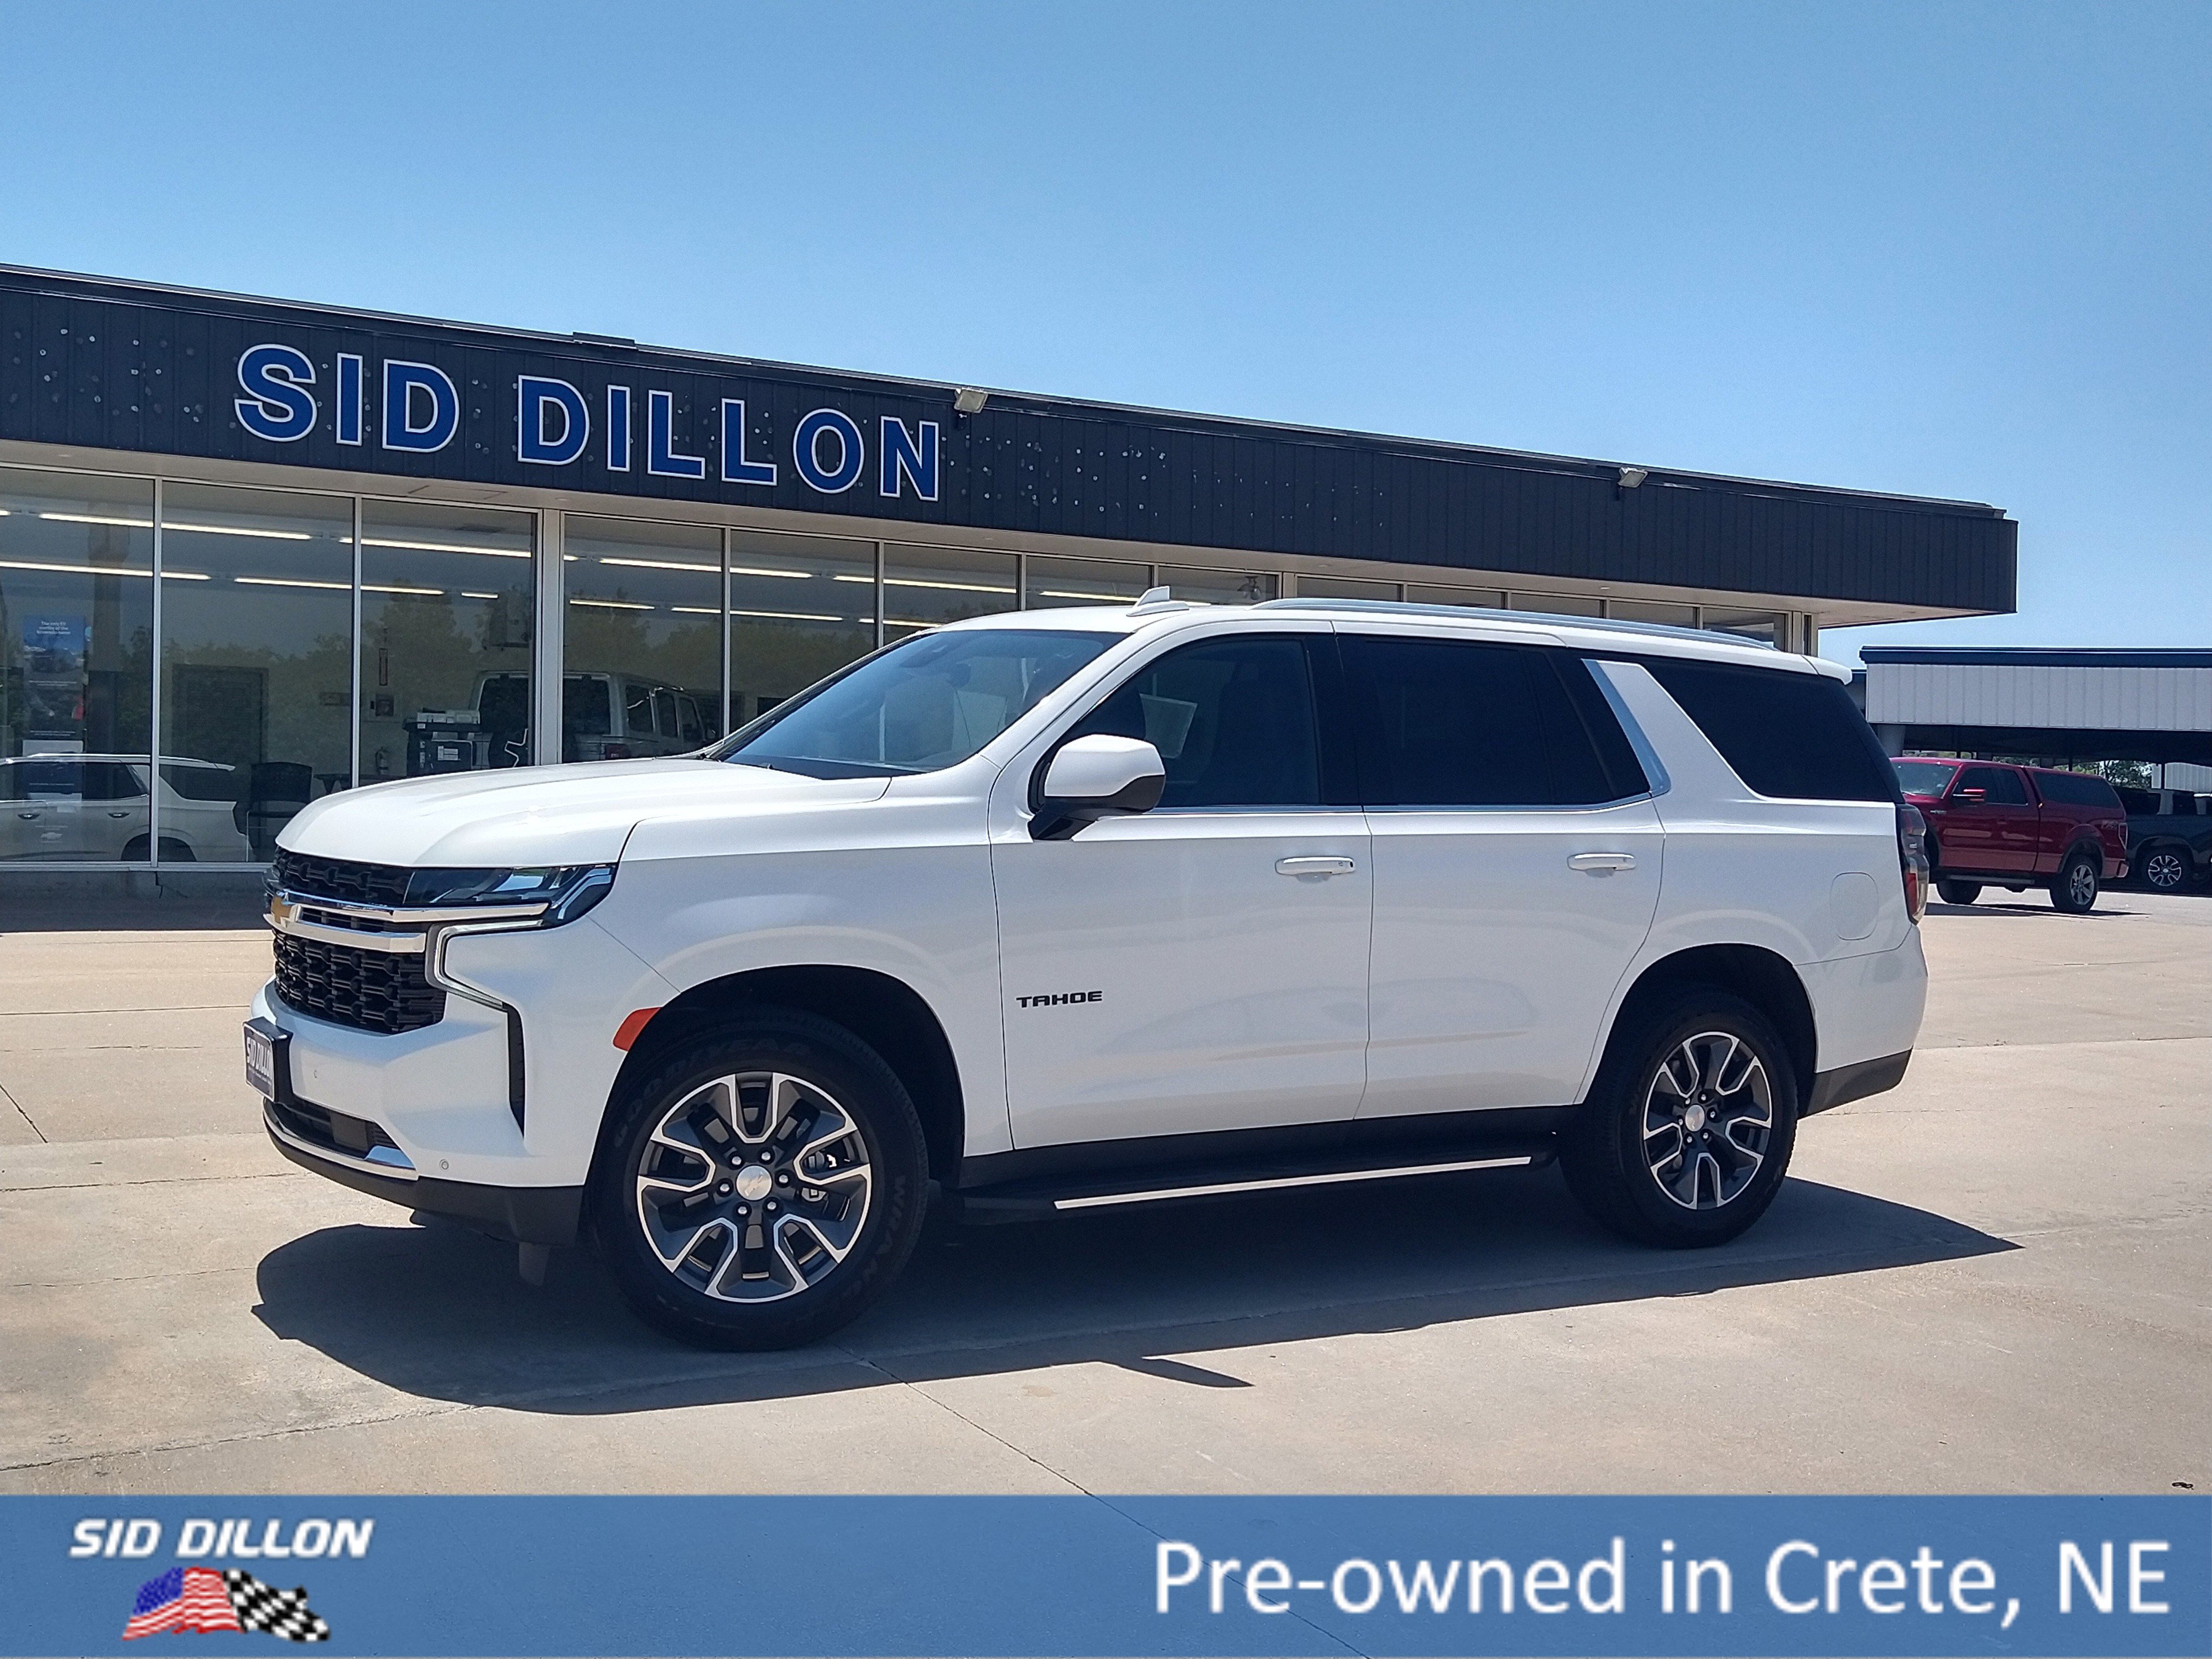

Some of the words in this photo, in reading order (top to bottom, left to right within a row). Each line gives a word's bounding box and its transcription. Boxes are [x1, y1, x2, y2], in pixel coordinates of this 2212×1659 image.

[234, 343, 460, 453] SID
[518, 375, 939, 502] DILLON
[1016, 990, 1103, 1008] TAHOE
